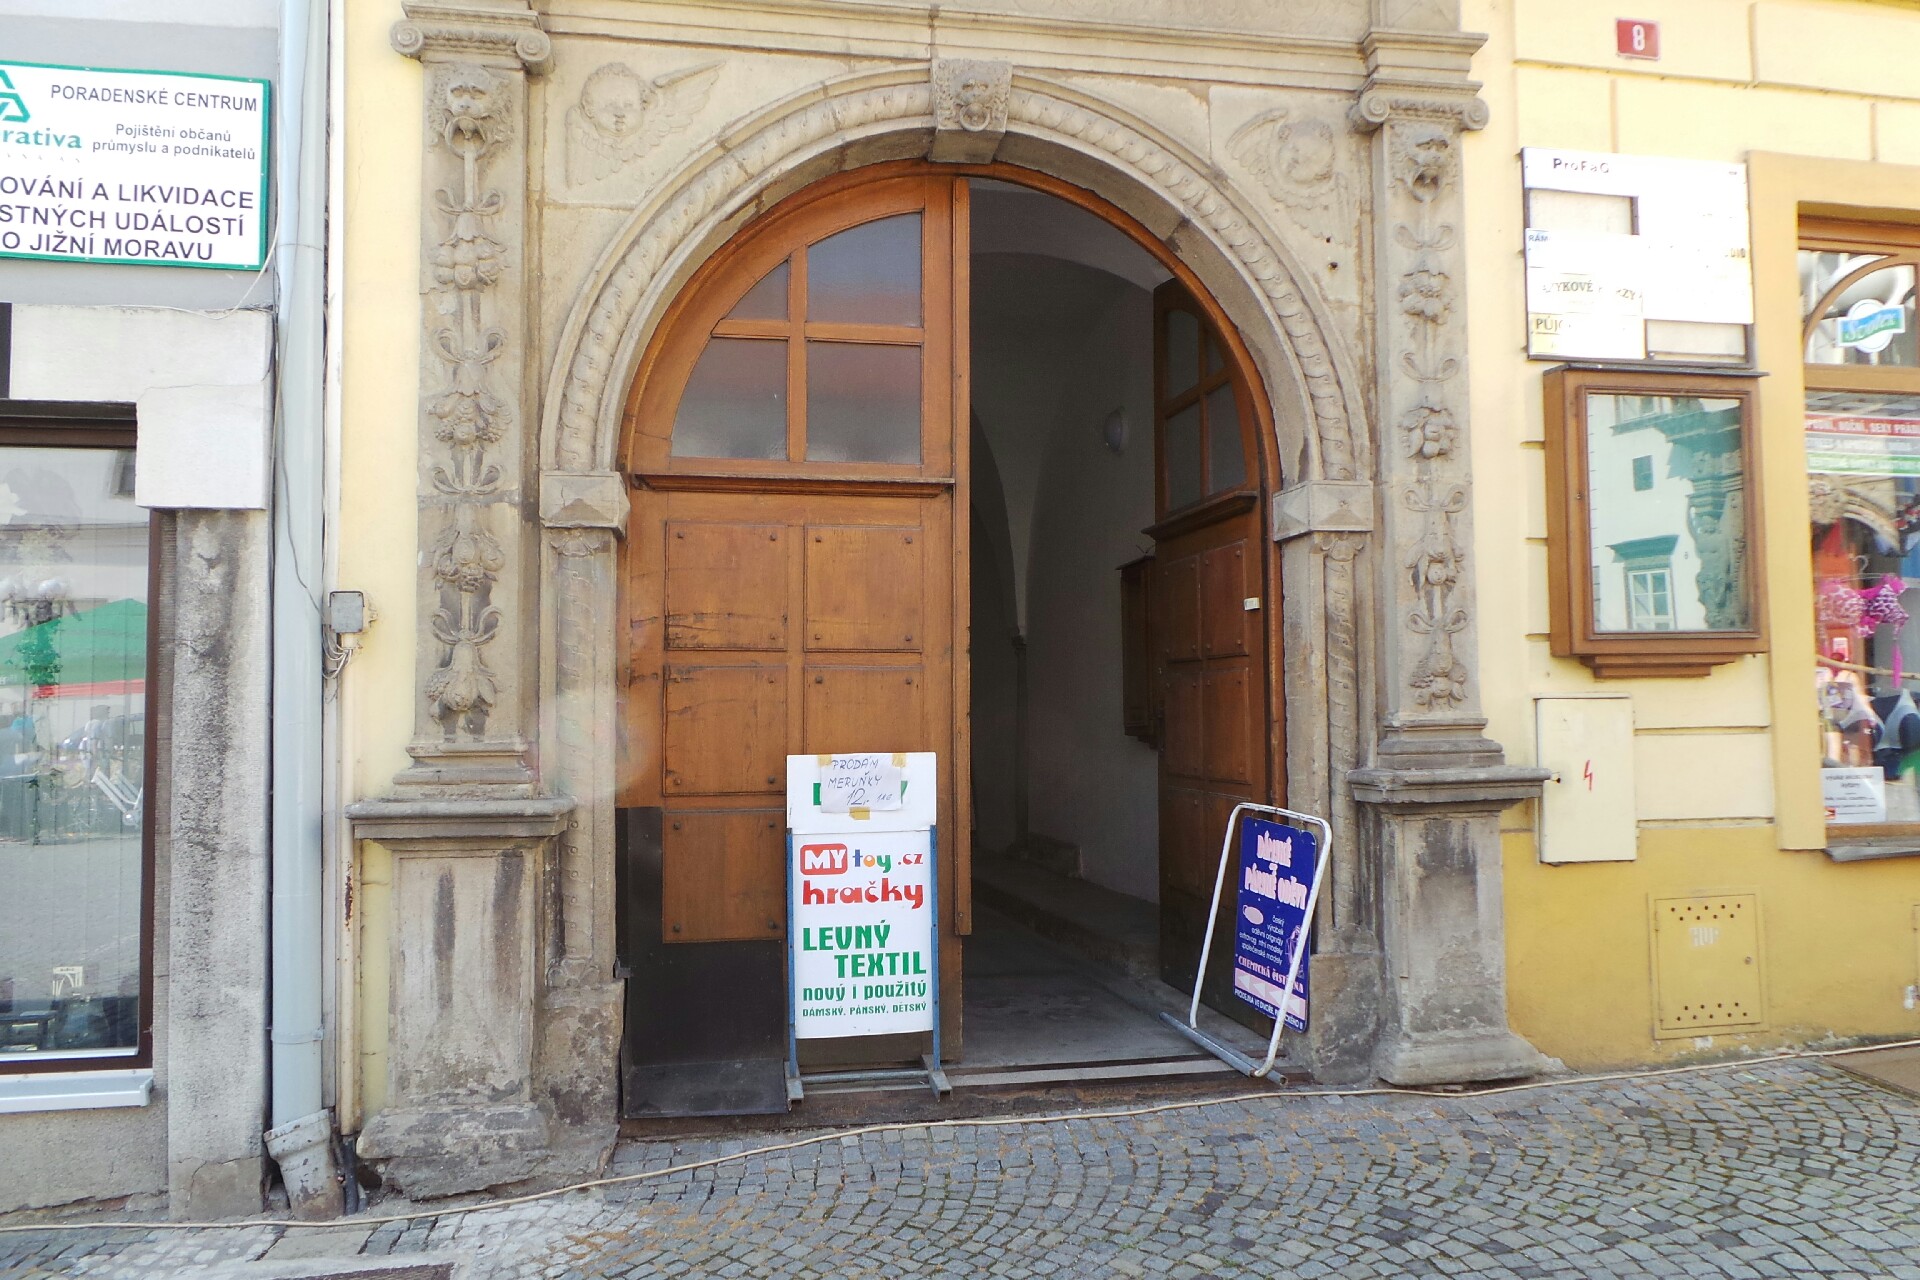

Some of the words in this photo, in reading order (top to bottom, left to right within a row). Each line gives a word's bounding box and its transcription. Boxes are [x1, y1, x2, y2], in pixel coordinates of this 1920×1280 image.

[1632, 24, 1645, 51] 8
[51, 84, 168, 105] PORADENSKÉ
[174, 92, 257, 111] CENTRUM
[116, 124, 175, 138] Pojištění
[180, 128, 231, 142] občanů
[92, 139, 157, 154] průmyslu
[161, 144, 169, 154] a
[174, 145, 255, 160] podnikatelů
[0, 175, 83, 199] OVÁNÍ
[92, 182, 109, 201] A
[119, 184, 254, 209] LIKVIDACE
[0, 204, 105, 229] STNÝCH
[116, 209, 244, 236] UDÁLOSTÍ
[2, 231, 21, 249] O
[30, 230, 94, 255] JIŽNÍ
[104, 237, 213, 261] MORAVU
[832, 757, 879, 770] PRODÁM
[828, 771, 882, 788] MERUŇKY
[804, 849, 846, 870] MY
[802, 878, 924, 909] hračky
[802, 920, 890, 951] LEVNÝ
[834, 951, 927, 978] TEXTIL
[802, 984, 845, 1002] nový
[852, 984, 857, 1000] i
[864, 980, 927, 1001] použitý
